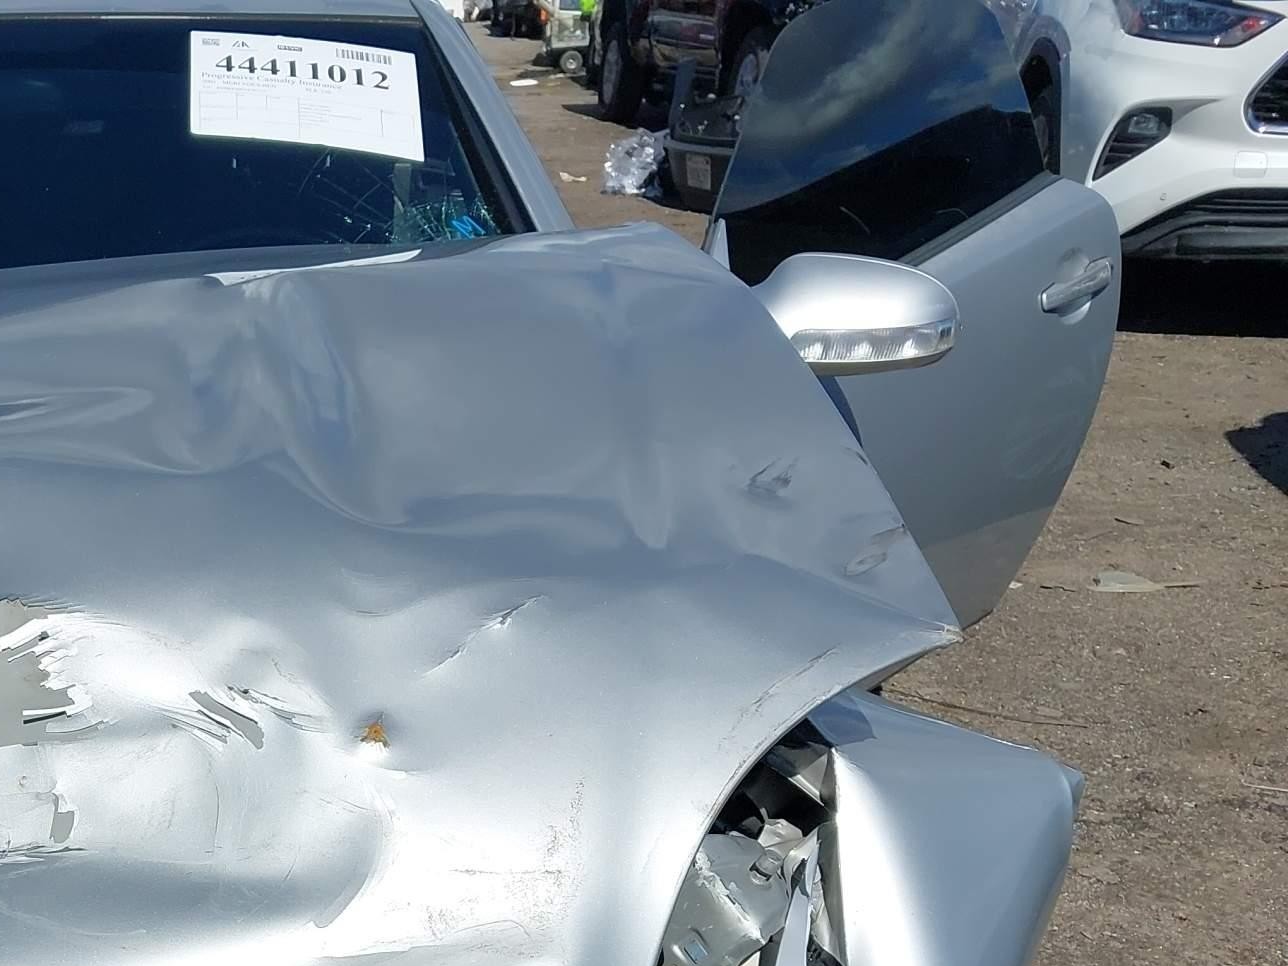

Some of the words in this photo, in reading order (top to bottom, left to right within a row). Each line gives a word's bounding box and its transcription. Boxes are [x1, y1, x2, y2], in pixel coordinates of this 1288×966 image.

[201, 71, 255, 82] Progressive
[257, 75, 297, 86] Casualty
[215, 54, 390, 91] 44411012
